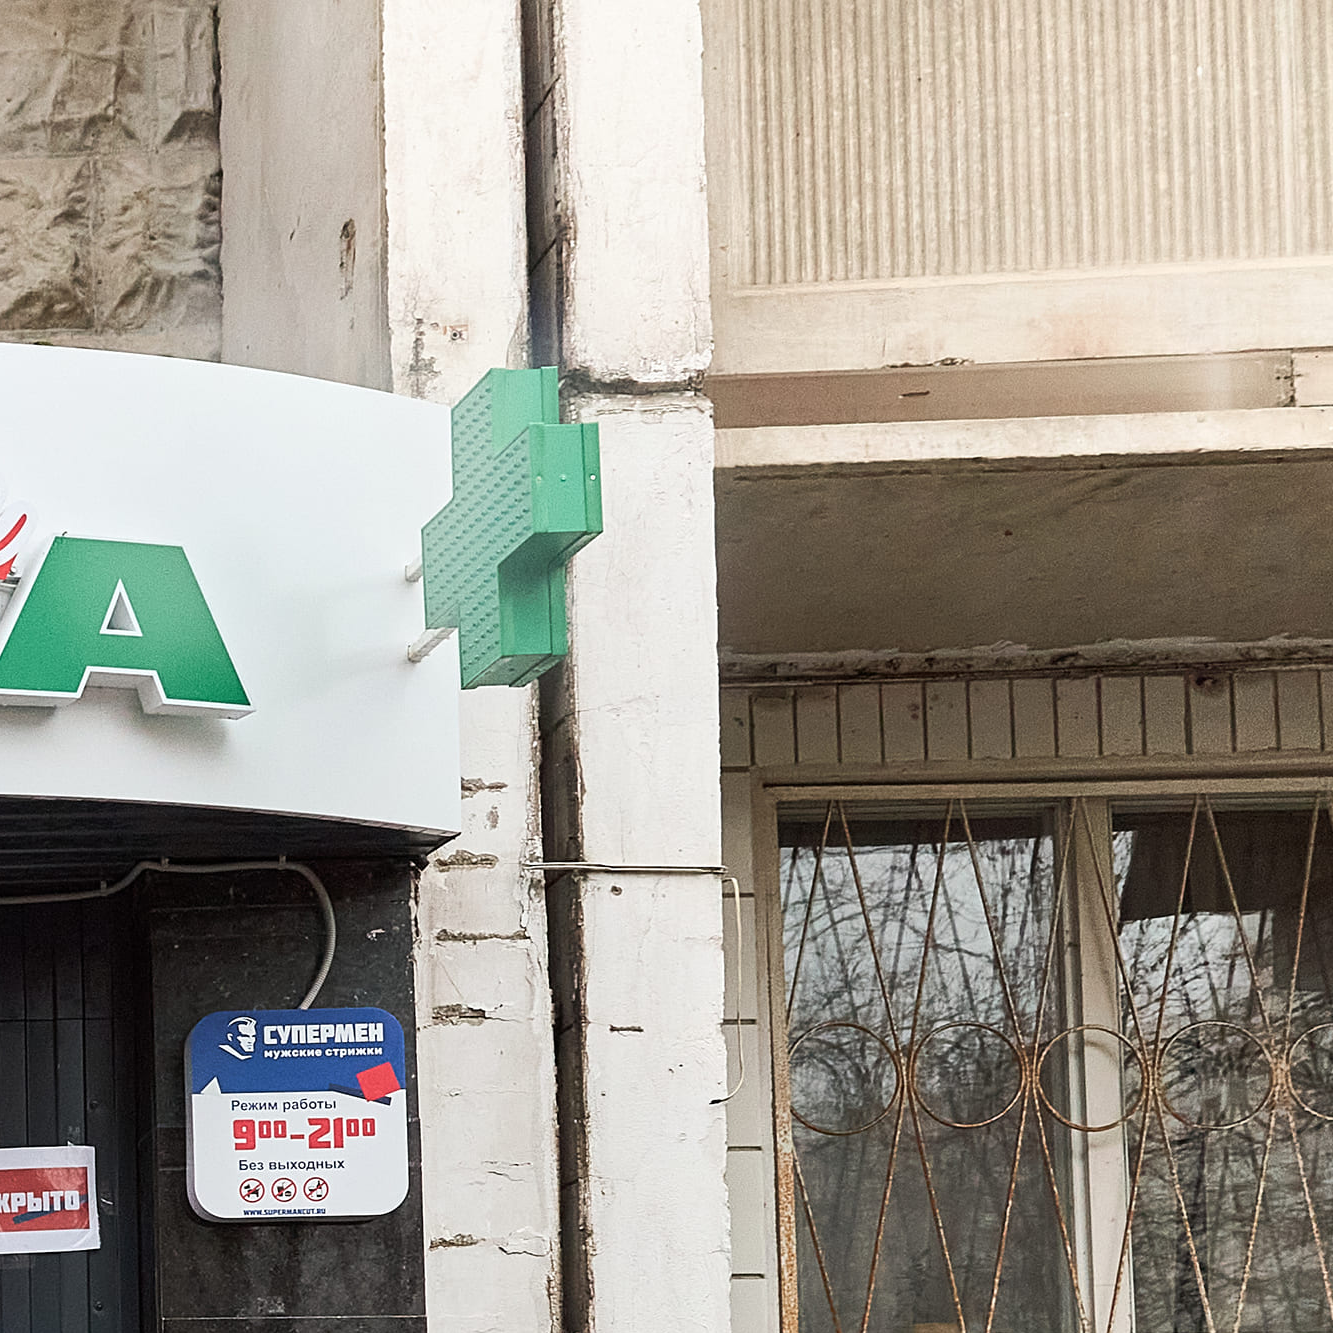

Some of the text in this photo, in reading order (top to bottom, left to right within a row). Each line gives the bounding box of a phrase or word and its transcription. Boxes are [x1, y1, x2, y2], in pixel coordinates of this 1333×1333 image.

[263, 1022, 384, 1045] СУПЕРМЕН
[263, 1047, 383, 1060] мужские стрижки
[231, 1099, 337, 1113] Режим работы
[238, 1159, 345, 1171] Без выходных
